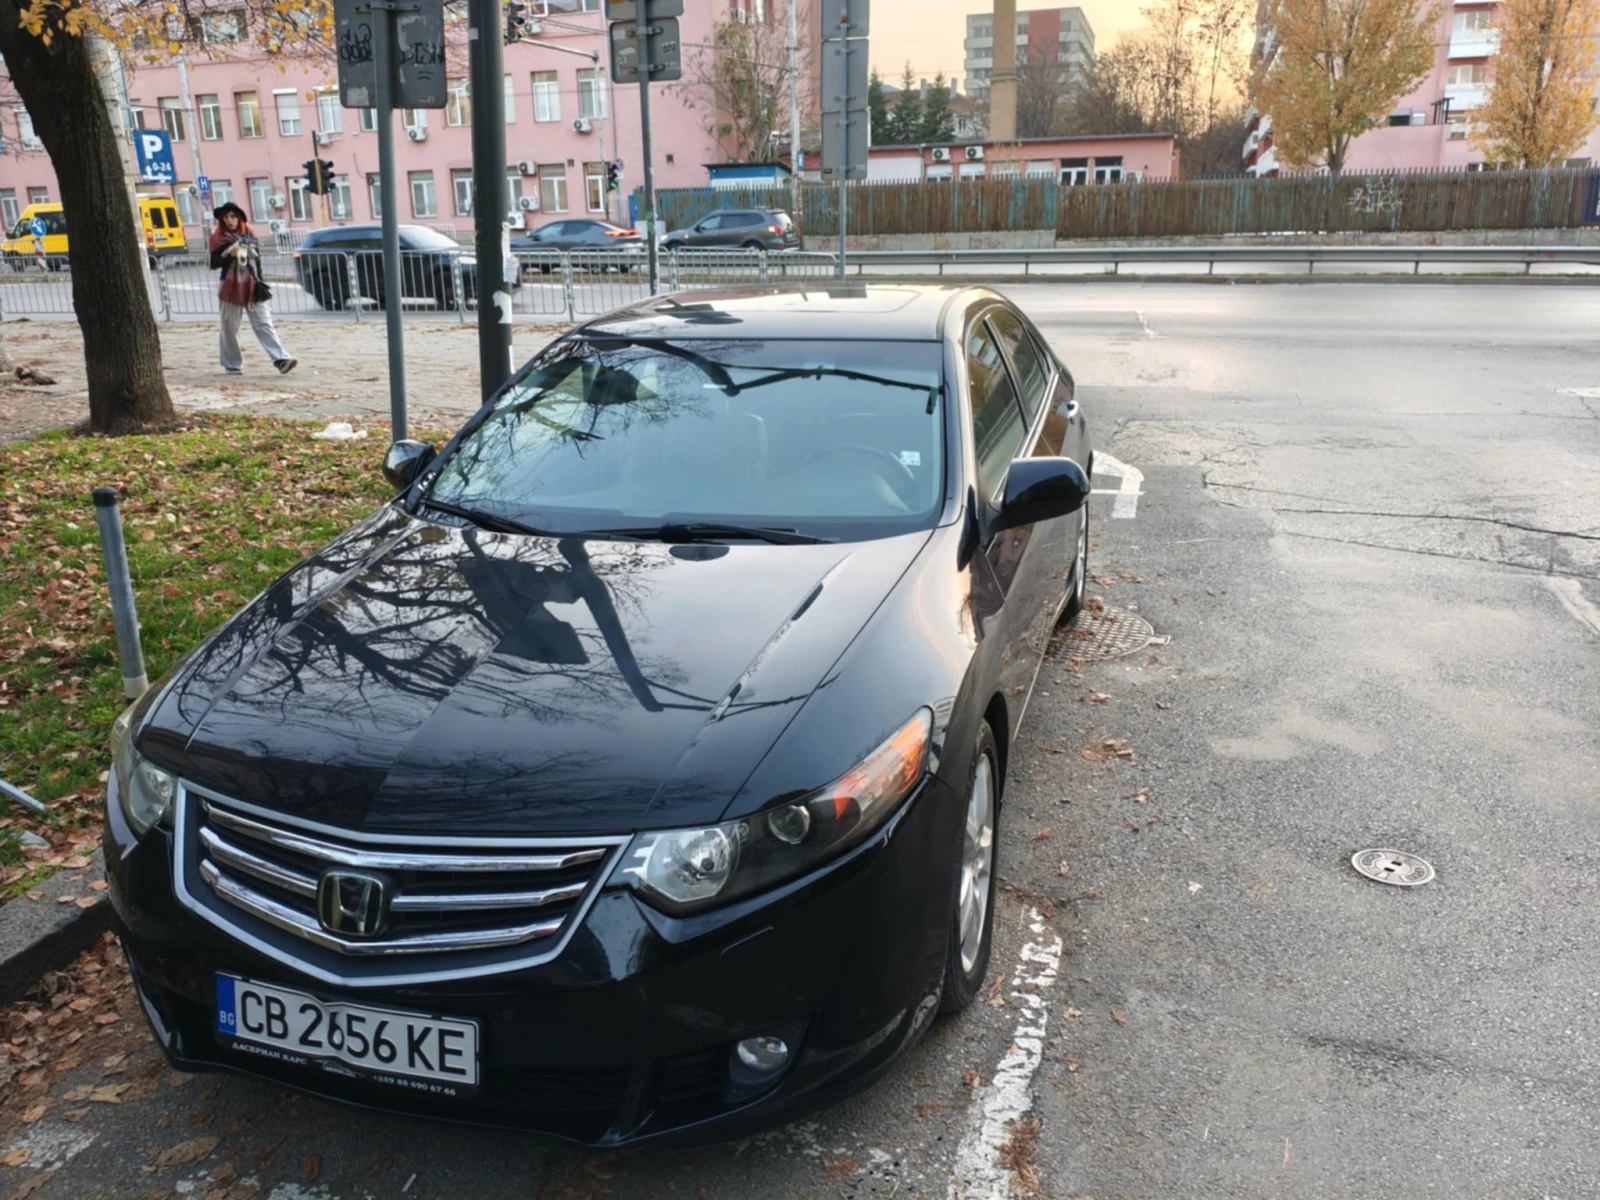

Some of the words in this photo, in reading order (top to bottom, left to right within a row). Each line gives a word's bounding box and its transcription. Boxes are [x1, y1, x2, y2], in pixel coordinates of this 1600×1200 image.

[142, 134, 163, 159] P
[152, 162, 172, 172] 0-24
[220, 1010, 235, 1026] BG
[241, 990, 288, 1040] CB
[299, 1003, 397, 1064] 2656
[407, 1024, 466, 1075] KE
[410, 1080, 428, 1091] 690
[430, 1085, 442, 1094] 67
[444, 1088, 456, 1096] 66
